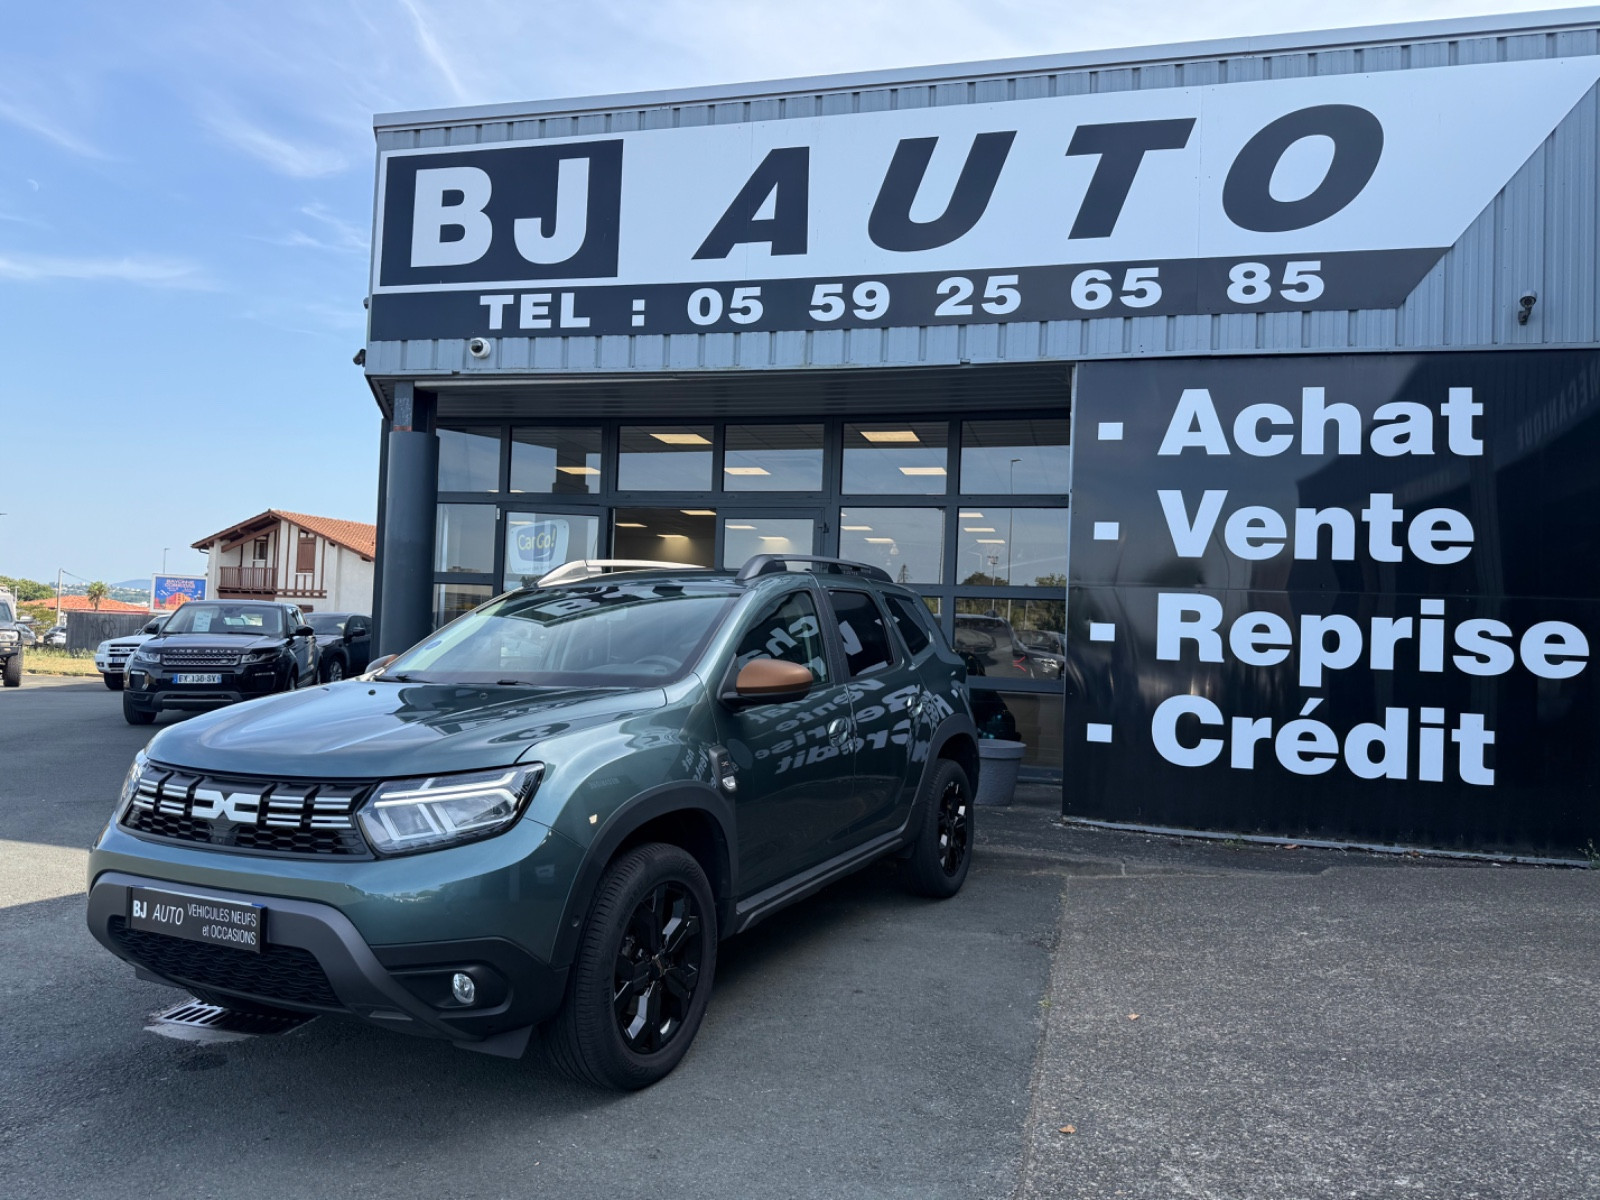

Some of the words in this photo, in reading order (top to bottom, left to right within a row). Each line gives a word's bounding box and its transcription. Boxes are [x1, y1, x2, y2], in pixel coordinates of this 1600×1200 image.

[410, 157, 590, 268] BJ
[692, 104, 1384, 259] AUTO
[479, 293, 591, 330] TEL
[687, 286, 764, 326] 05
[808, 281, 890, 322] 59
[934, 274, 1022, 316] 25
[1070, 267, 1163, 311] 65
[1226, 259, 1325, 304] 85
[1157, 386, 1484, 457] Achat
[1156, 489, 1475, 565] Vente
[1156, 592, 1590, 688] Reprise
[1151, 683, 1495, 786] Crédit
[132, 900, 148, 918] BJ
[152, 903, 184, 925] AUTO
[187, 903, 230, 922] VEHICULES
[231, 910, 257, 927] NEUFS
[202, 925, 210, 937] et
[211, 924, 256, 945] OCCASIONS
